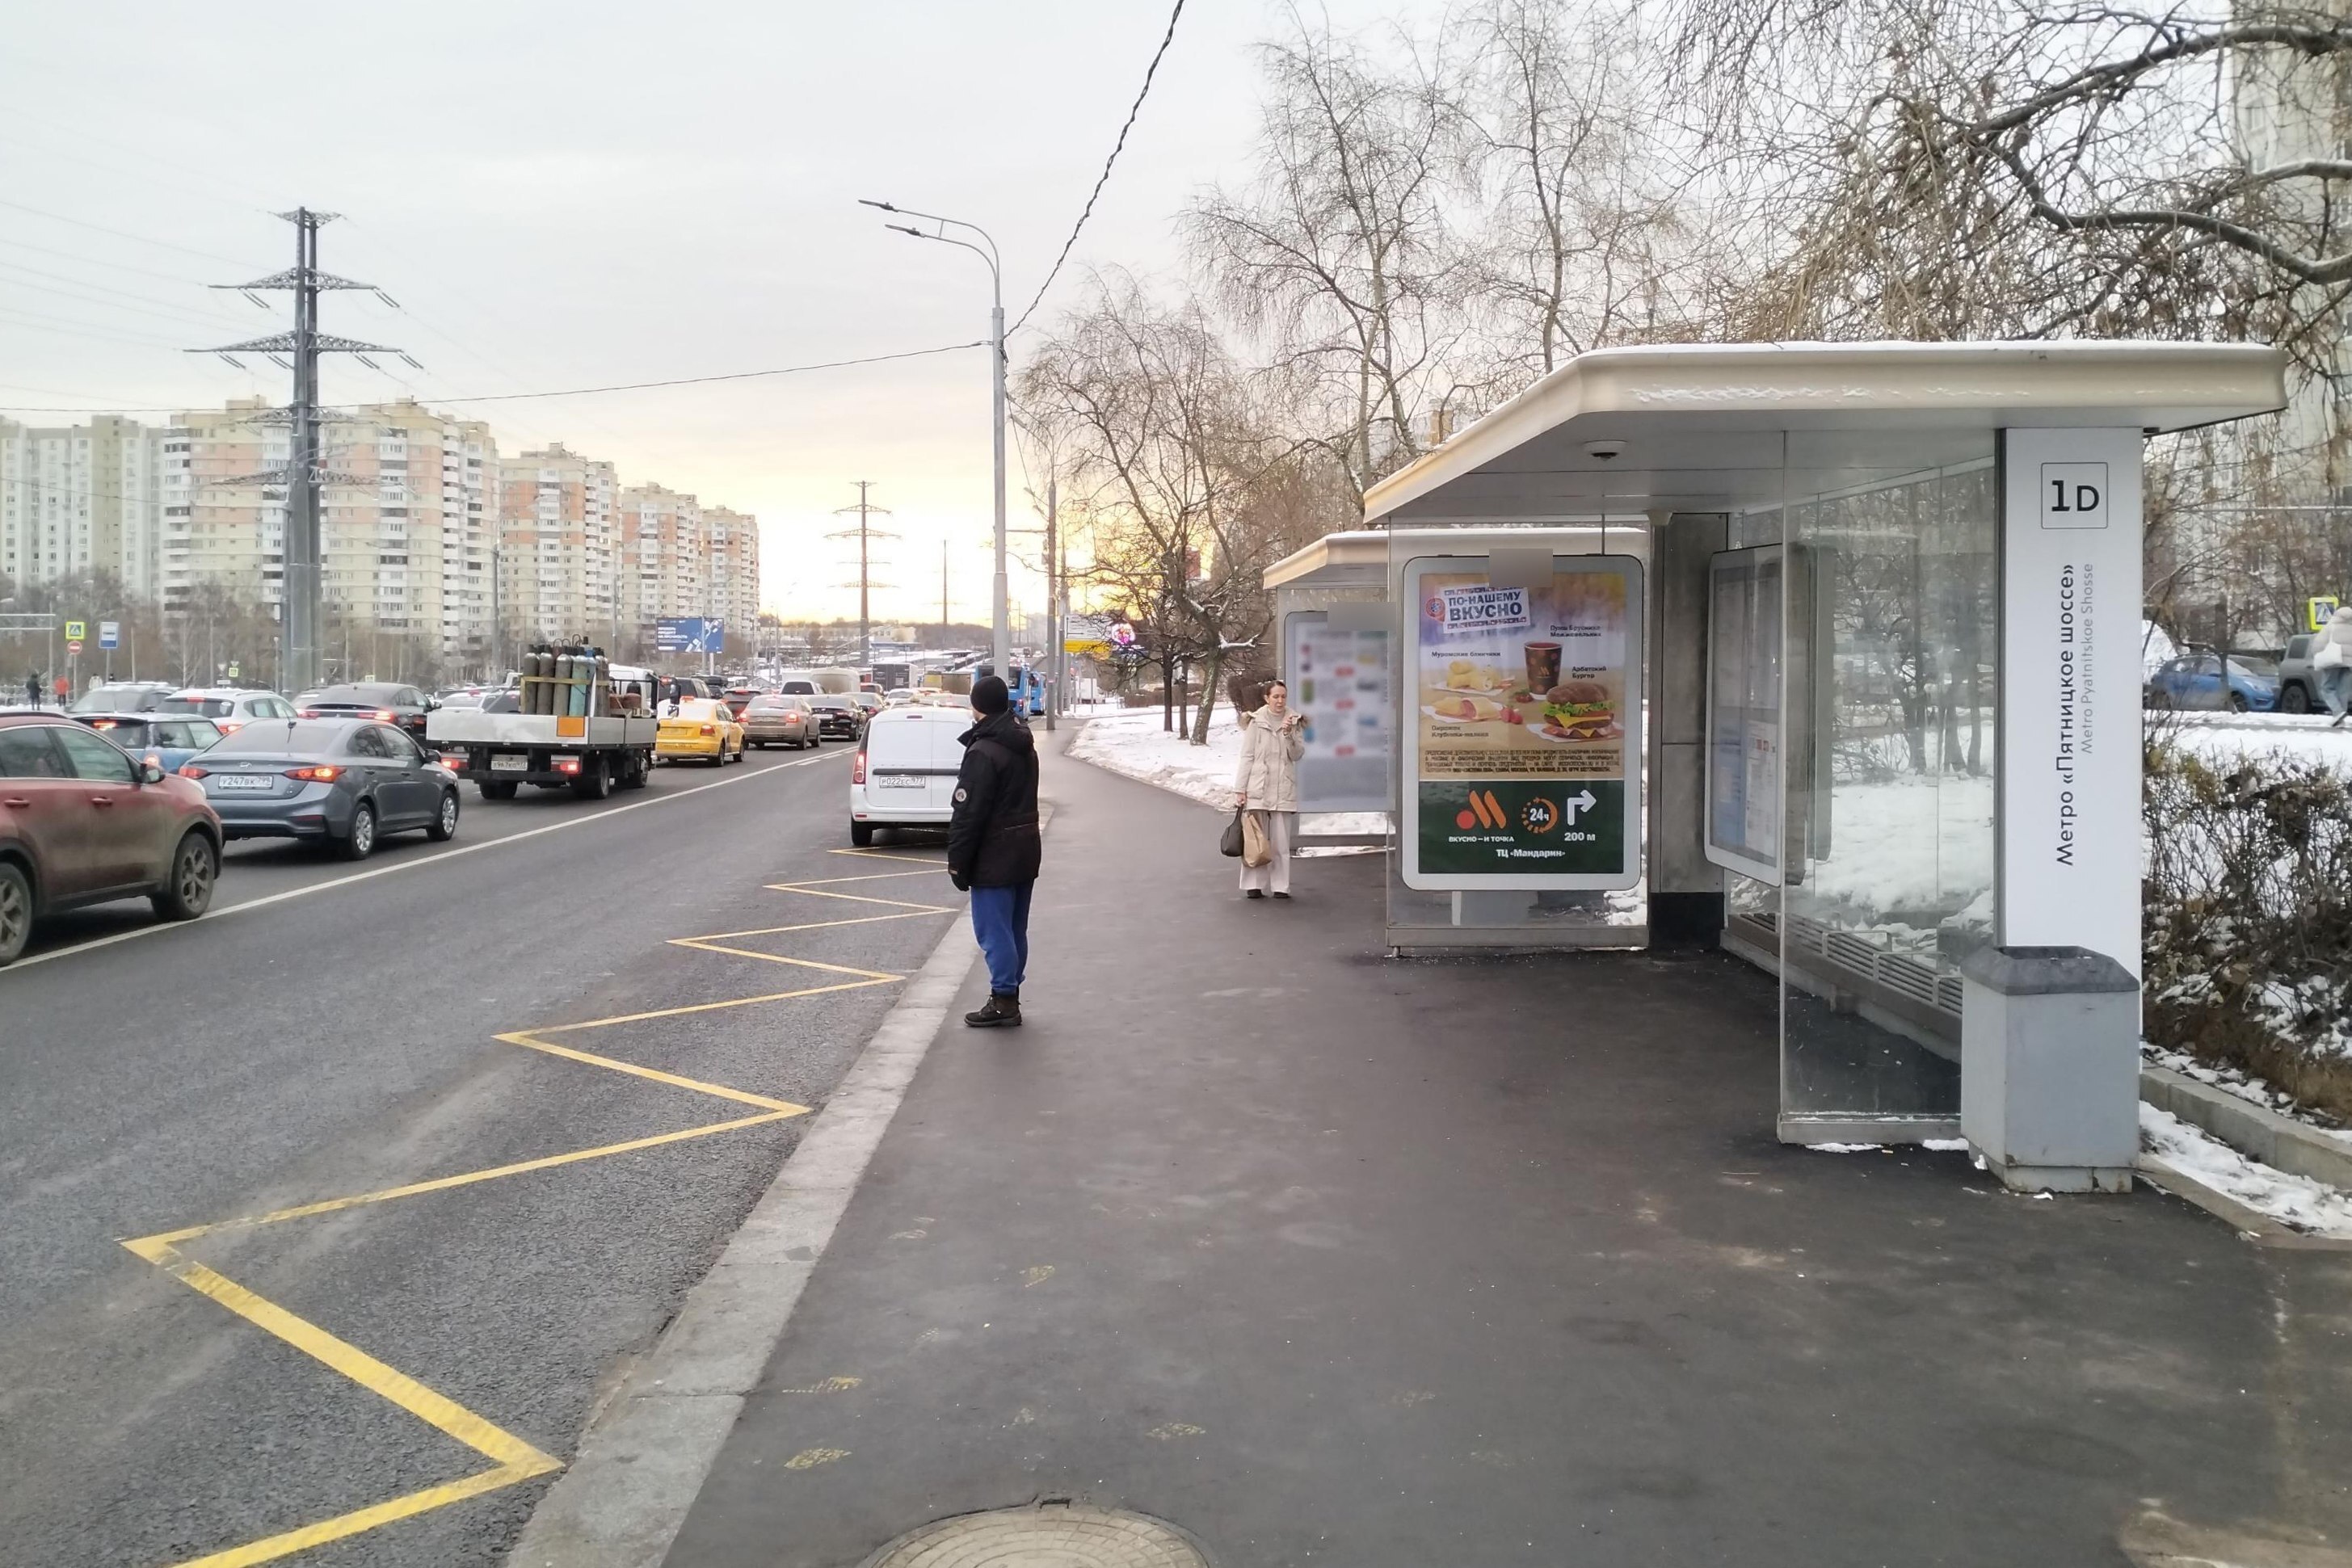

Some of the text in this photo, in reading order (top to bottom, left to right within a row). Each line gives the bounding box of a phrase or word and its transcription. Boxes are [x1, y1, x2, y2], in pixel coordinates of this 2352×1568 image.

[2051, 480, 2100, 512] 1D
[1449, 591, 1521, 607] ПО-НАШЕМУ
[1449, 602, 1522, 621] ВКУСНО
[2081, 564, 2096, 754] Metro Pyatnitskoe Shosse
[2055, 565, 2077, 866] Метро «Пятницкое шоссе»
[1564, 832, 1584, 842] 200
[1496, 849, 1566, 859] ТЦ «Мандарин»
